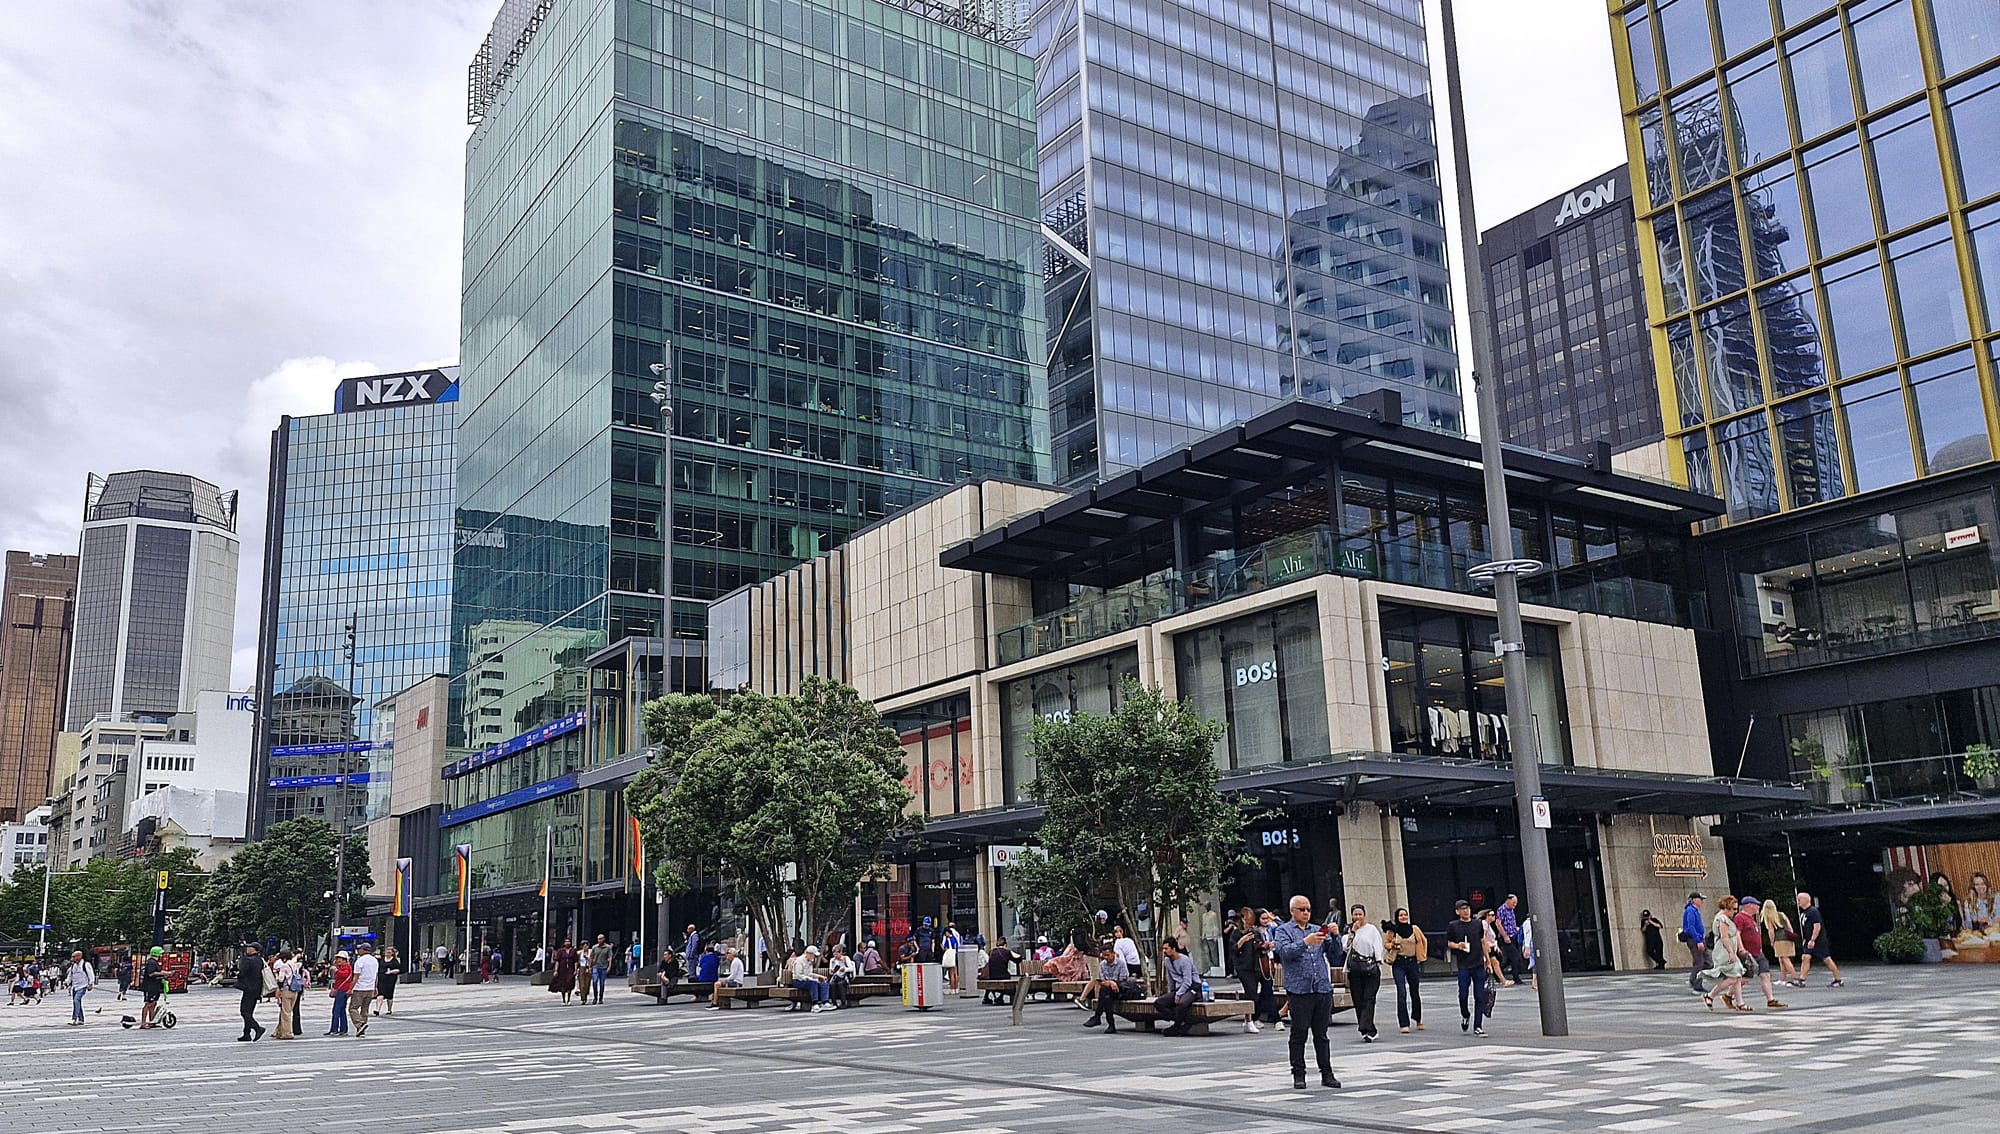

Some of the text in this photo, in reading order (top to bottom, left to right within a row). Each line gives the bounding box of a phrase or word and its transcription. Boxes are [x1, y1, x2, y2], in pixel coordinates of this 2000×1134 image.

[1554, 178, 1616, 227] AON
[356, 374, 432, 406] NZX
[1653, 833, 1703, 854] QUEENS
